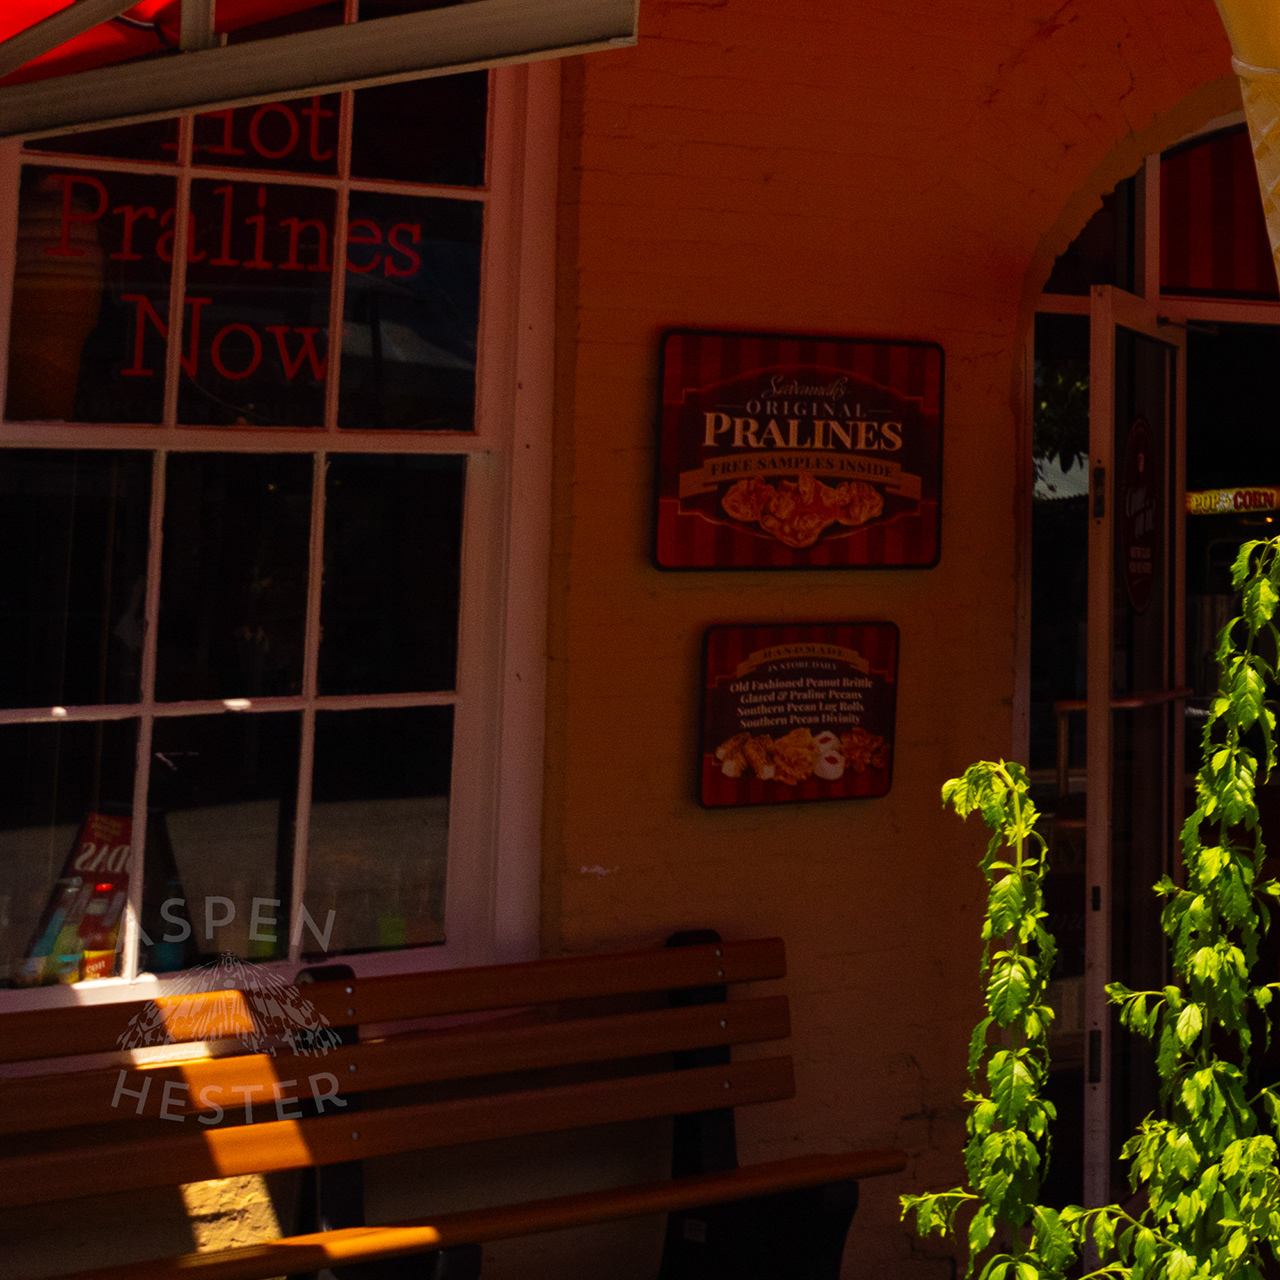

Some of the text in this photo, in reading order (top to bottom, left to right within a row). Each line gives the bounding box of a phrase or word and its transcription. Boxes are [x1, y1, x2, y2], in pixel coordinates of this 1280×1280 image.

[45, 174, 423, 277] Pralines
[120, 293, 349, 381] Now
[746, 400, 867, 418] ORIGINAL
[702, 411, 904, 452] PRALINES
[711, 457, 894, 477] FREE SAMPLES INSIDE
[1234, 491, 1274, 509] CORN
[763, 646, 843, 658] HANDMADE
[729, 676, 873, 693] Old Fashioned Peanut Brittle
[777, 691, 788, 701] &
[790, 689, 826, 700] Praline
[828, 689, 863, 700] Pecans
[737, 701, 864, 717] Southern Pecan Log Rolls
[740, 713, 860, 729] Southern Pecan Divinity
